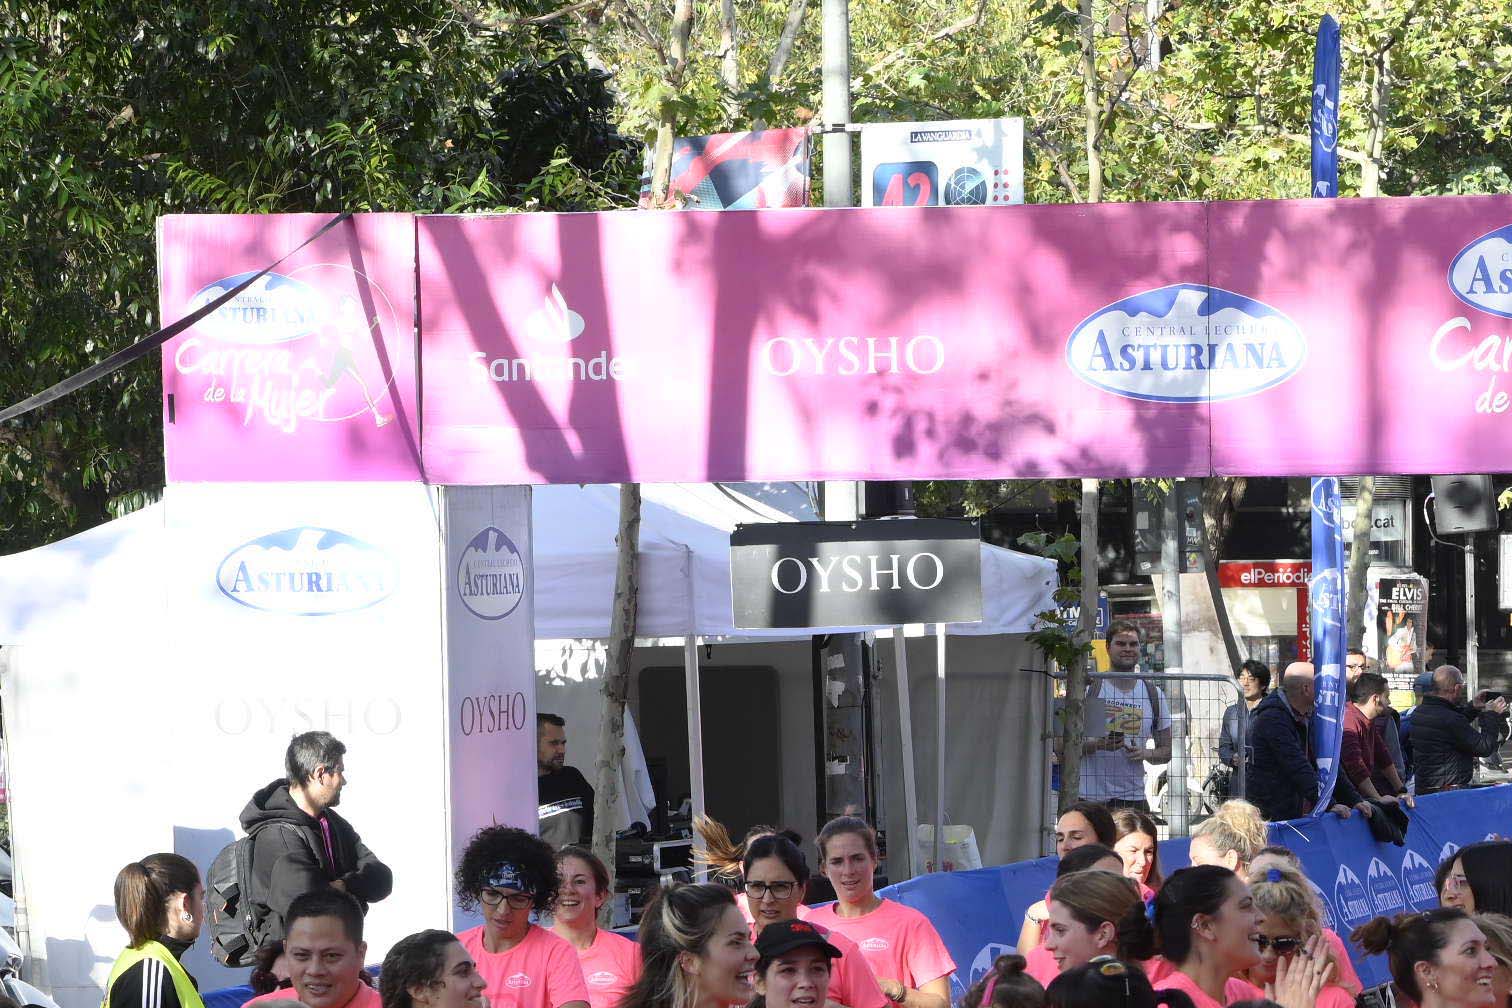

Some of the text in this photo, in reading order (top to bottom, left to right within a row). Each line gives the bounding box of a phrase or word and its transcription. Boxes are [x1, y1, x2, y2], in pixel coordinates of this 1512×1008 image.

[1121, 324, 1198, 337] CENTRAL
[471, 348, 637, 384] Santande
[762, 334, 945, 377] OYSHO
[1086, 328, 1287, 373] ASTURIANA
[1475, 381, 1511, 414] de
[463, 561, 521, 597] ASTURIANA
[771, 551, 946, 594] OYSHO
[1391, 587, 1423, 600] ELVIS
[214, 698, 402, 737] OYSHO
[461, 691, 526, 736] OYSHO
